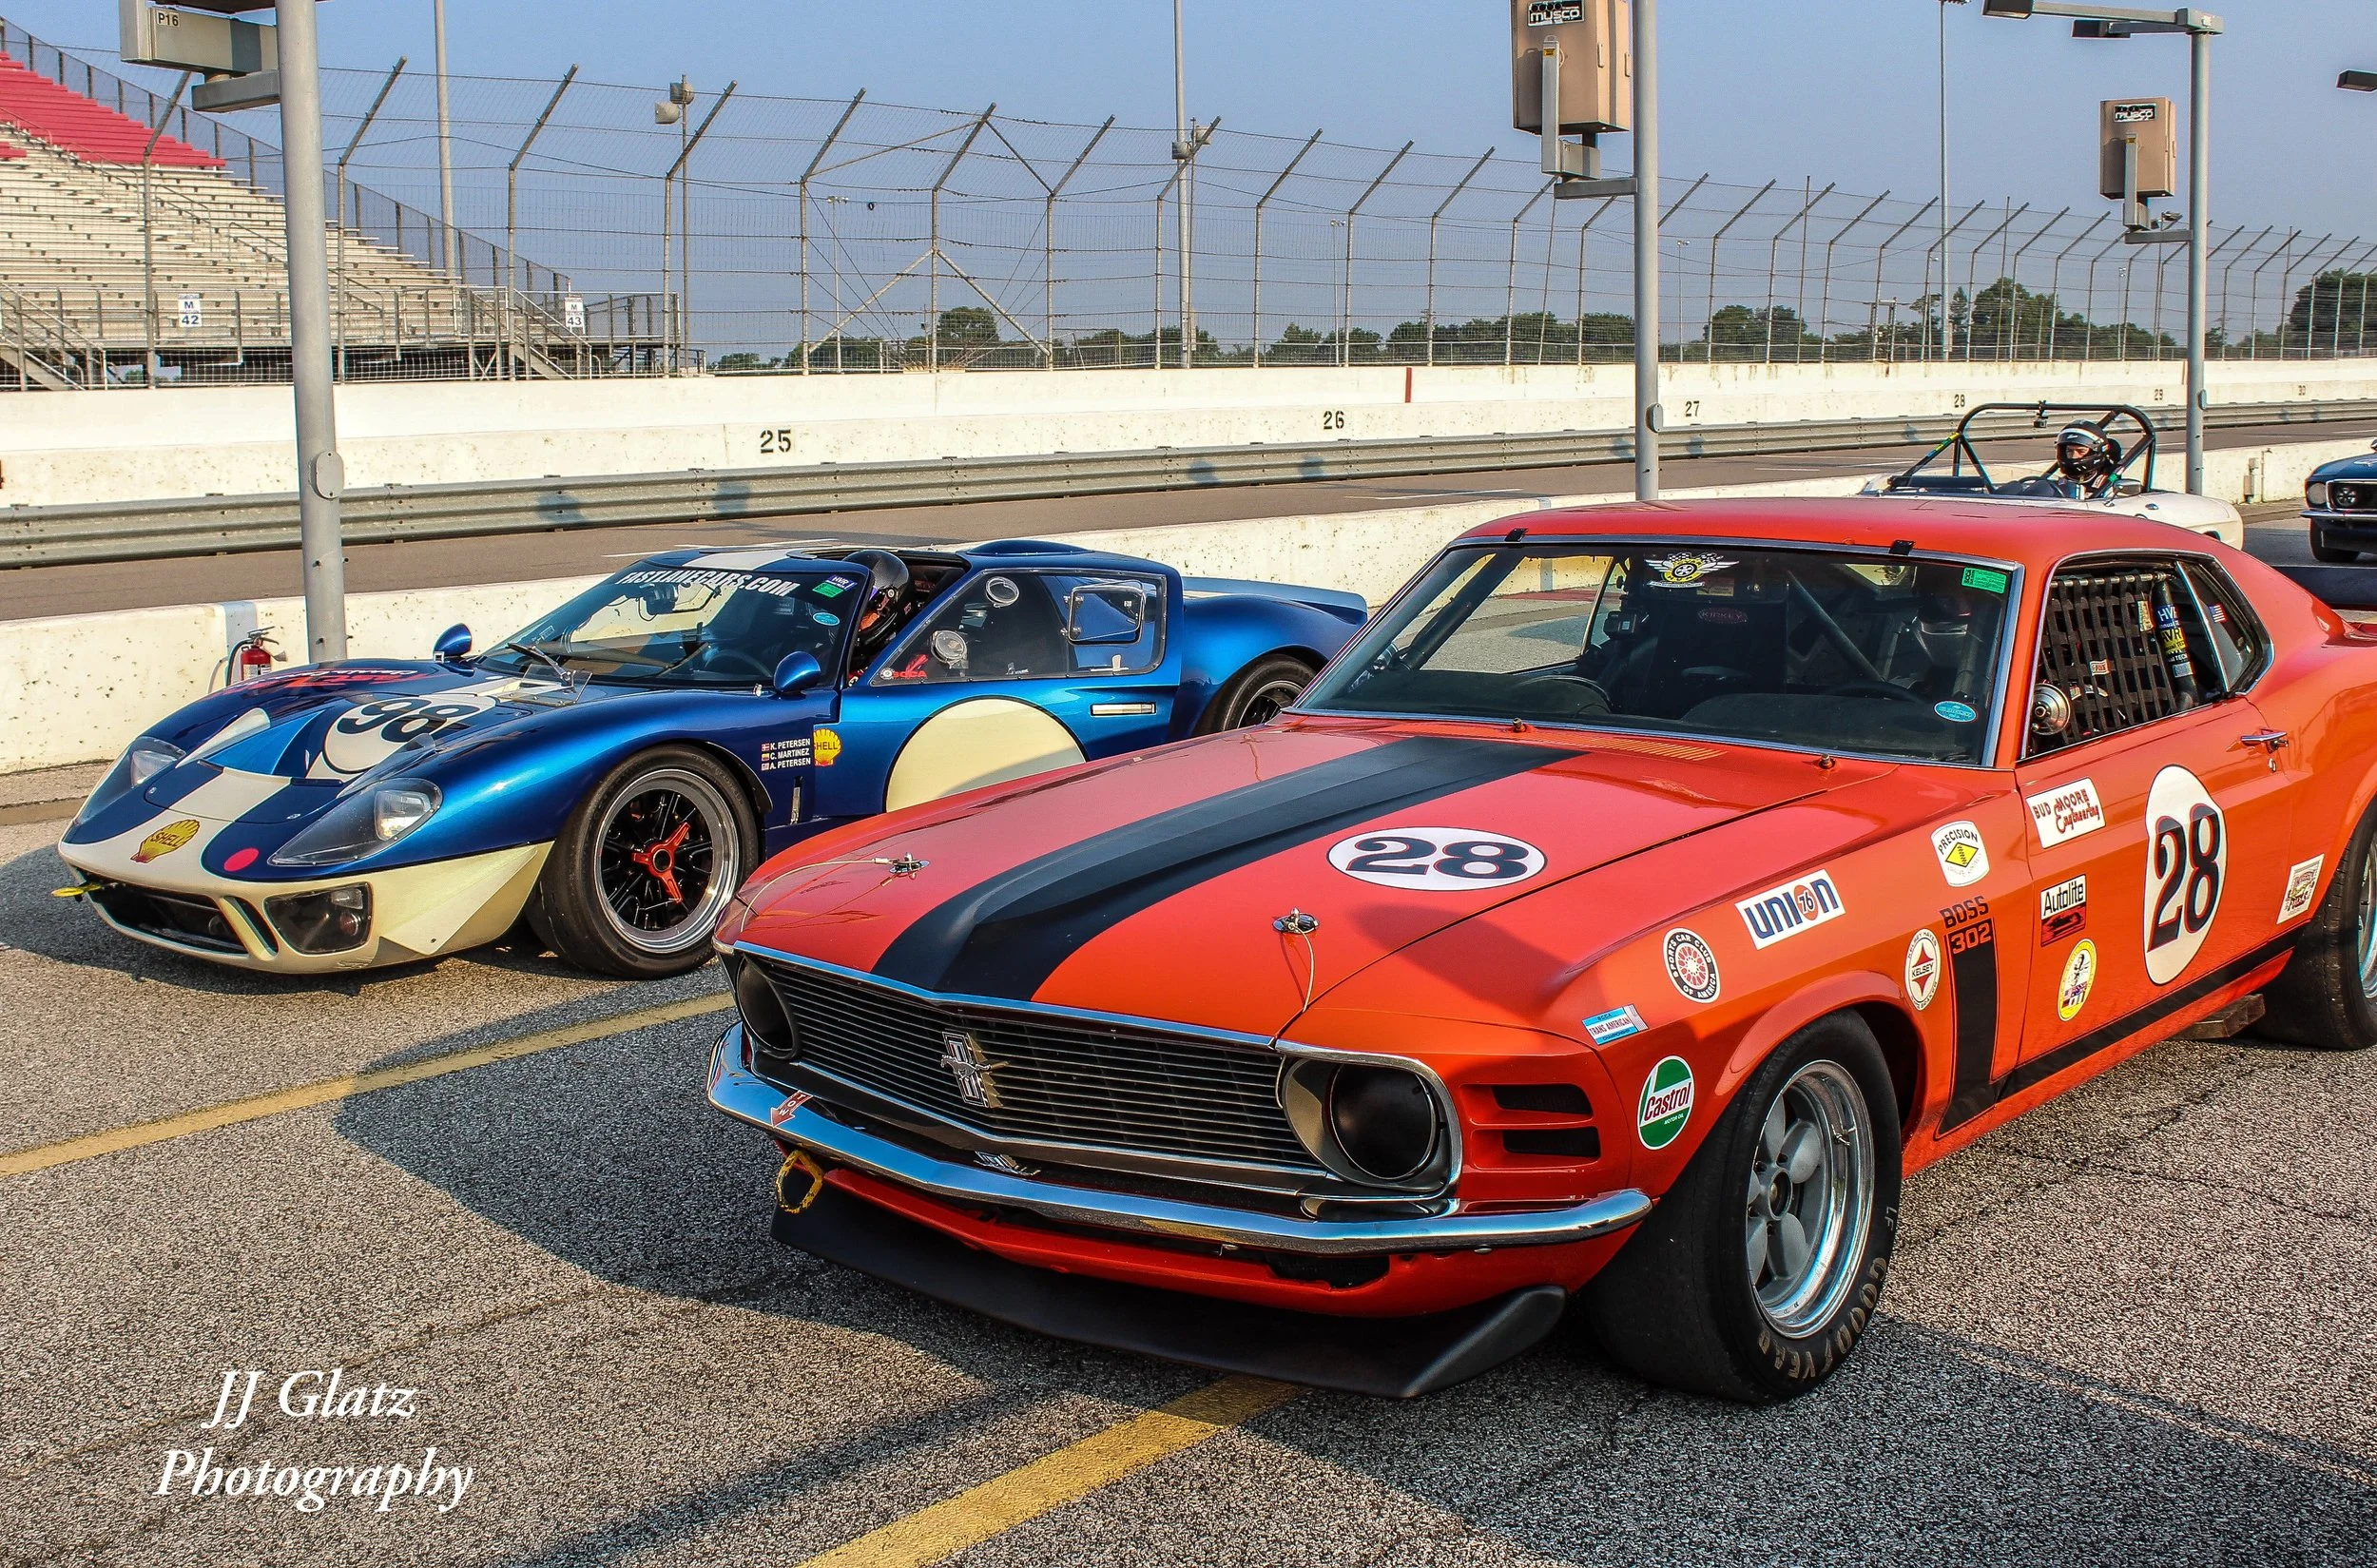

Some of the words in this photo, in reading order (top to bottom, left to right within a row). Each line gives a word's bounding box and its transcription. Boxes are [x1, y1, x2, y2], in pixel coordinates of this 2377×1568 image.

[158, 12, 179, 27] P16
[184, 300, 194, 310] M
[181, 315, 200, 325] 42
[568, 317, 582, 325] 43
[1685, 400, 1700, 417] 27
[1954, 394, 1965, 408] 28
[1323, 410, 1344, 430] 26
[760, 429, 791, 454] 25
[615, 570, 802, 598] FASTLANECARS.COM
[337, 698, 482, 744] 98
[770, 743, 777, 751] K.
[778, 738, 810, 750] PETERSEN
[778, 748, 810, 759] MARTINEZ
[778, 758, 811, 769] PETERSEN
[2032, 802, 2052, 819] BUD
[2054, 788, 2090, 812] MOORE
[150, 831, 181, 847] SHELL
[1938, 828, 1979, 856] PRECISION
[1345, 836, 1530, 880] 28
[2147, 803, 2221, 953] 28
[1798, 890, 1814, 914] 76
[2043, 880, 2084, 917] Autolite
[1940, 895, 1989, 929] BOSS
[1675, 934, 1691, 942] CAR
[1693, 939, 1712, 964] CLUB
[1950, 921, 1992, 955] 302
[1911, 962, 1934, 978] KELSEY
[1682, 984, 1693, 996] OF
[1696, 973, 1716, 998] AMERICA
[1589, 1024, 1607, 1036] TRANS
[779, 1094, 806, 1116] TOW
[1644, 1081, 1692, 1121] Castrol
